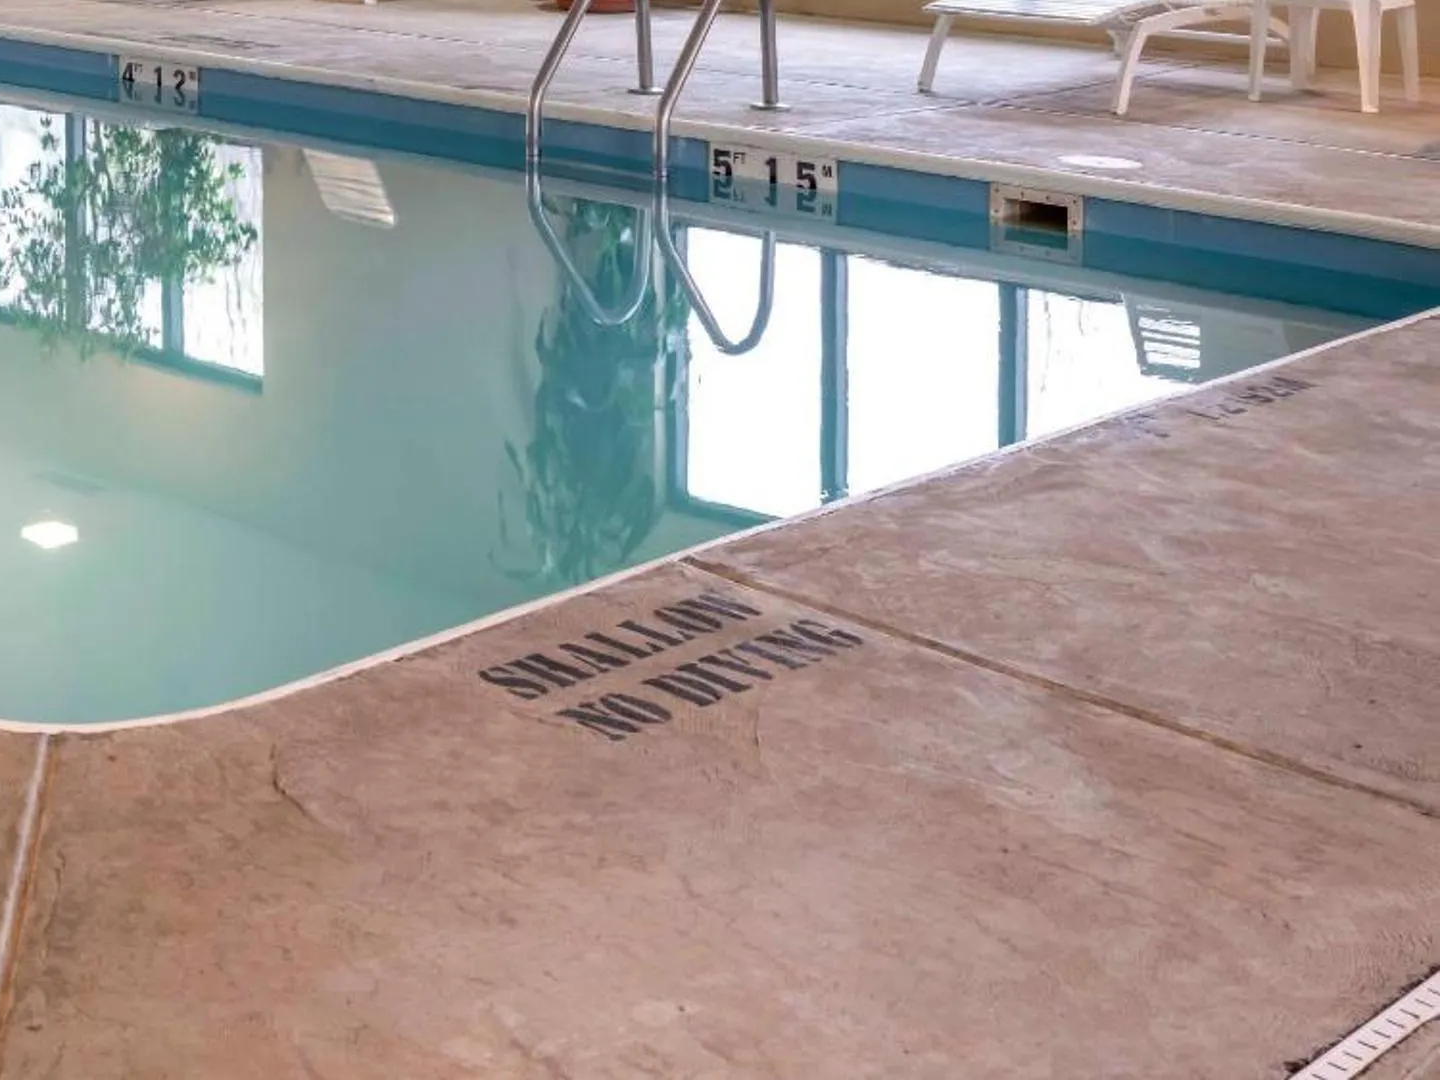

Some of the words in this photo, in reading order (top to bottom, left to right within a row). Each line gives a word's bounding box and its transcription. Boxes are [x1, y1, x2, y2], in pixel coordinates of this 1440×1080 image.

[478, 592, 764, 700] SHALLOW
[555, 693, 673, 741] NO
[642, 619, 865, 707] DIVING
